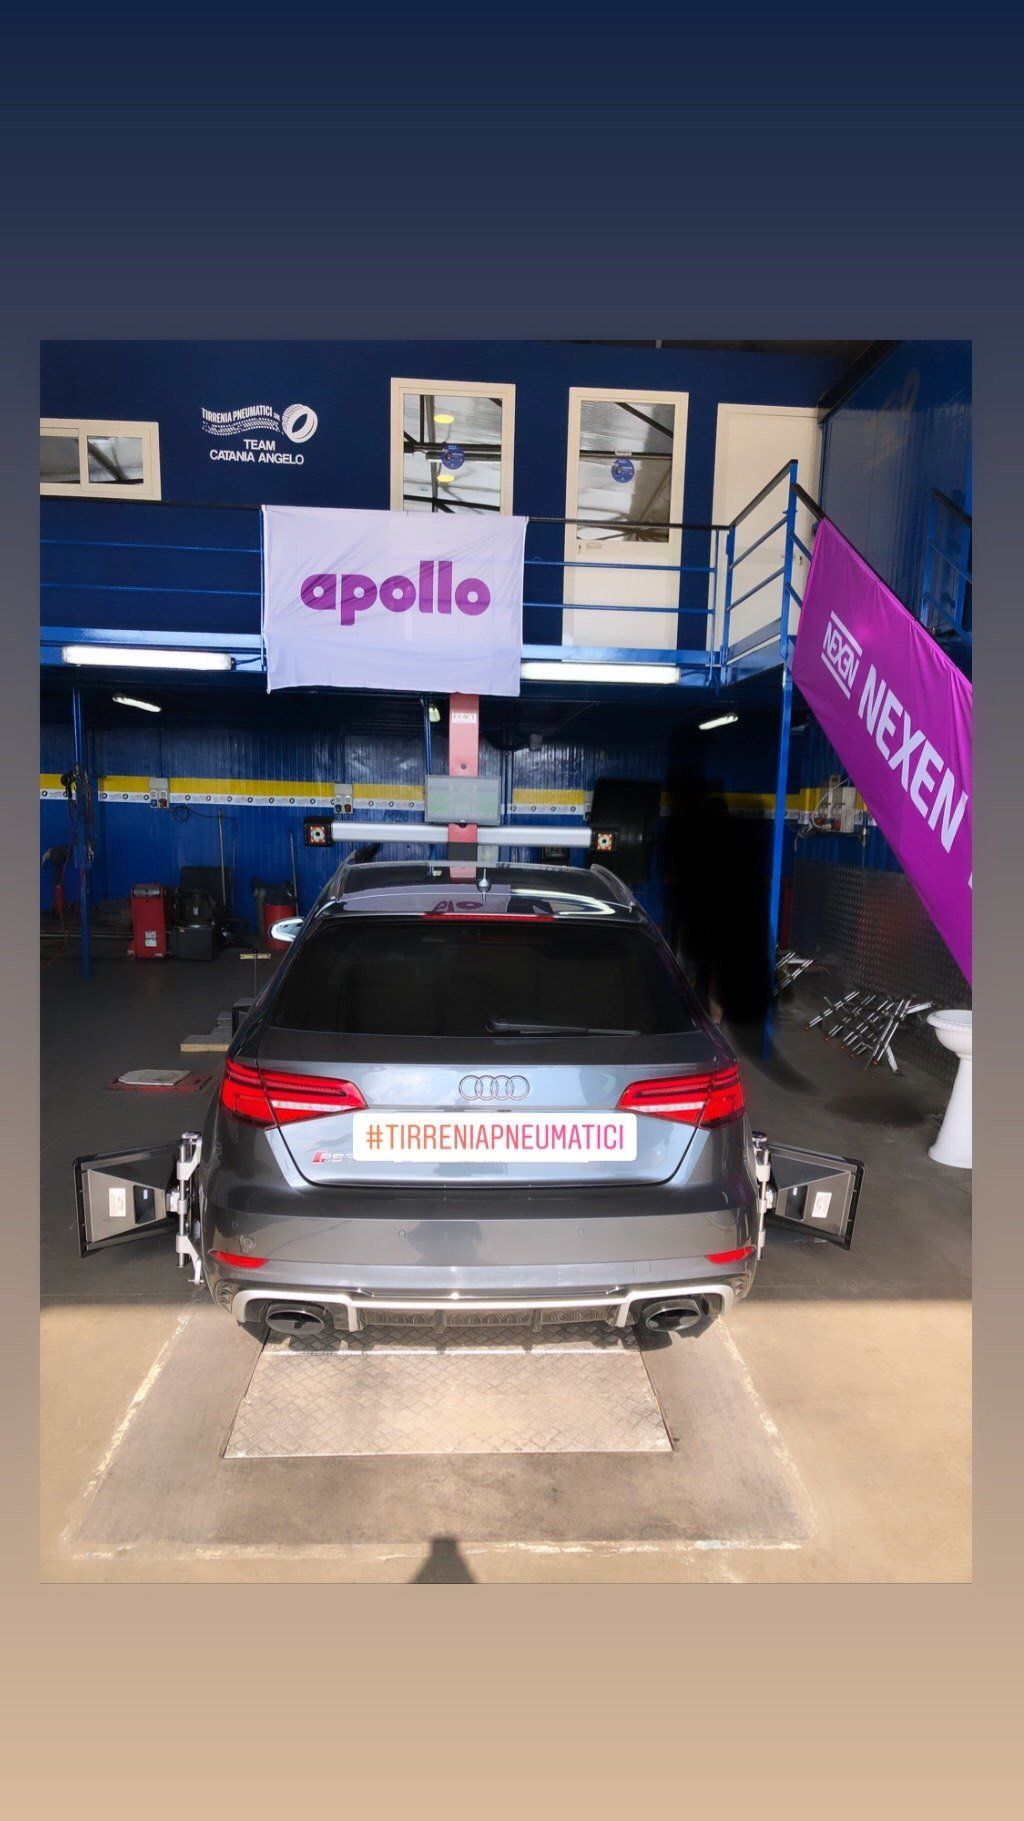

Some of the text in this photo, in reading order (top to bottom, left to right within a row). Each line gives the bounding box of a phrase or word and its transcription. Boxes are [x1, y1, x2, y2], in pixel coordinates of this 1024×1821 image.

[201, 407, 232, 424] TIRRENIA
[232, 405, 273, 421] PNEUMATICI
[243, 439, 276, 451] TEAM
[209, 449, 305, 465] CATANIA ANGELO
[300, 560, 491, 626] apollo
[857, 663, 969, 854] NEXEN
